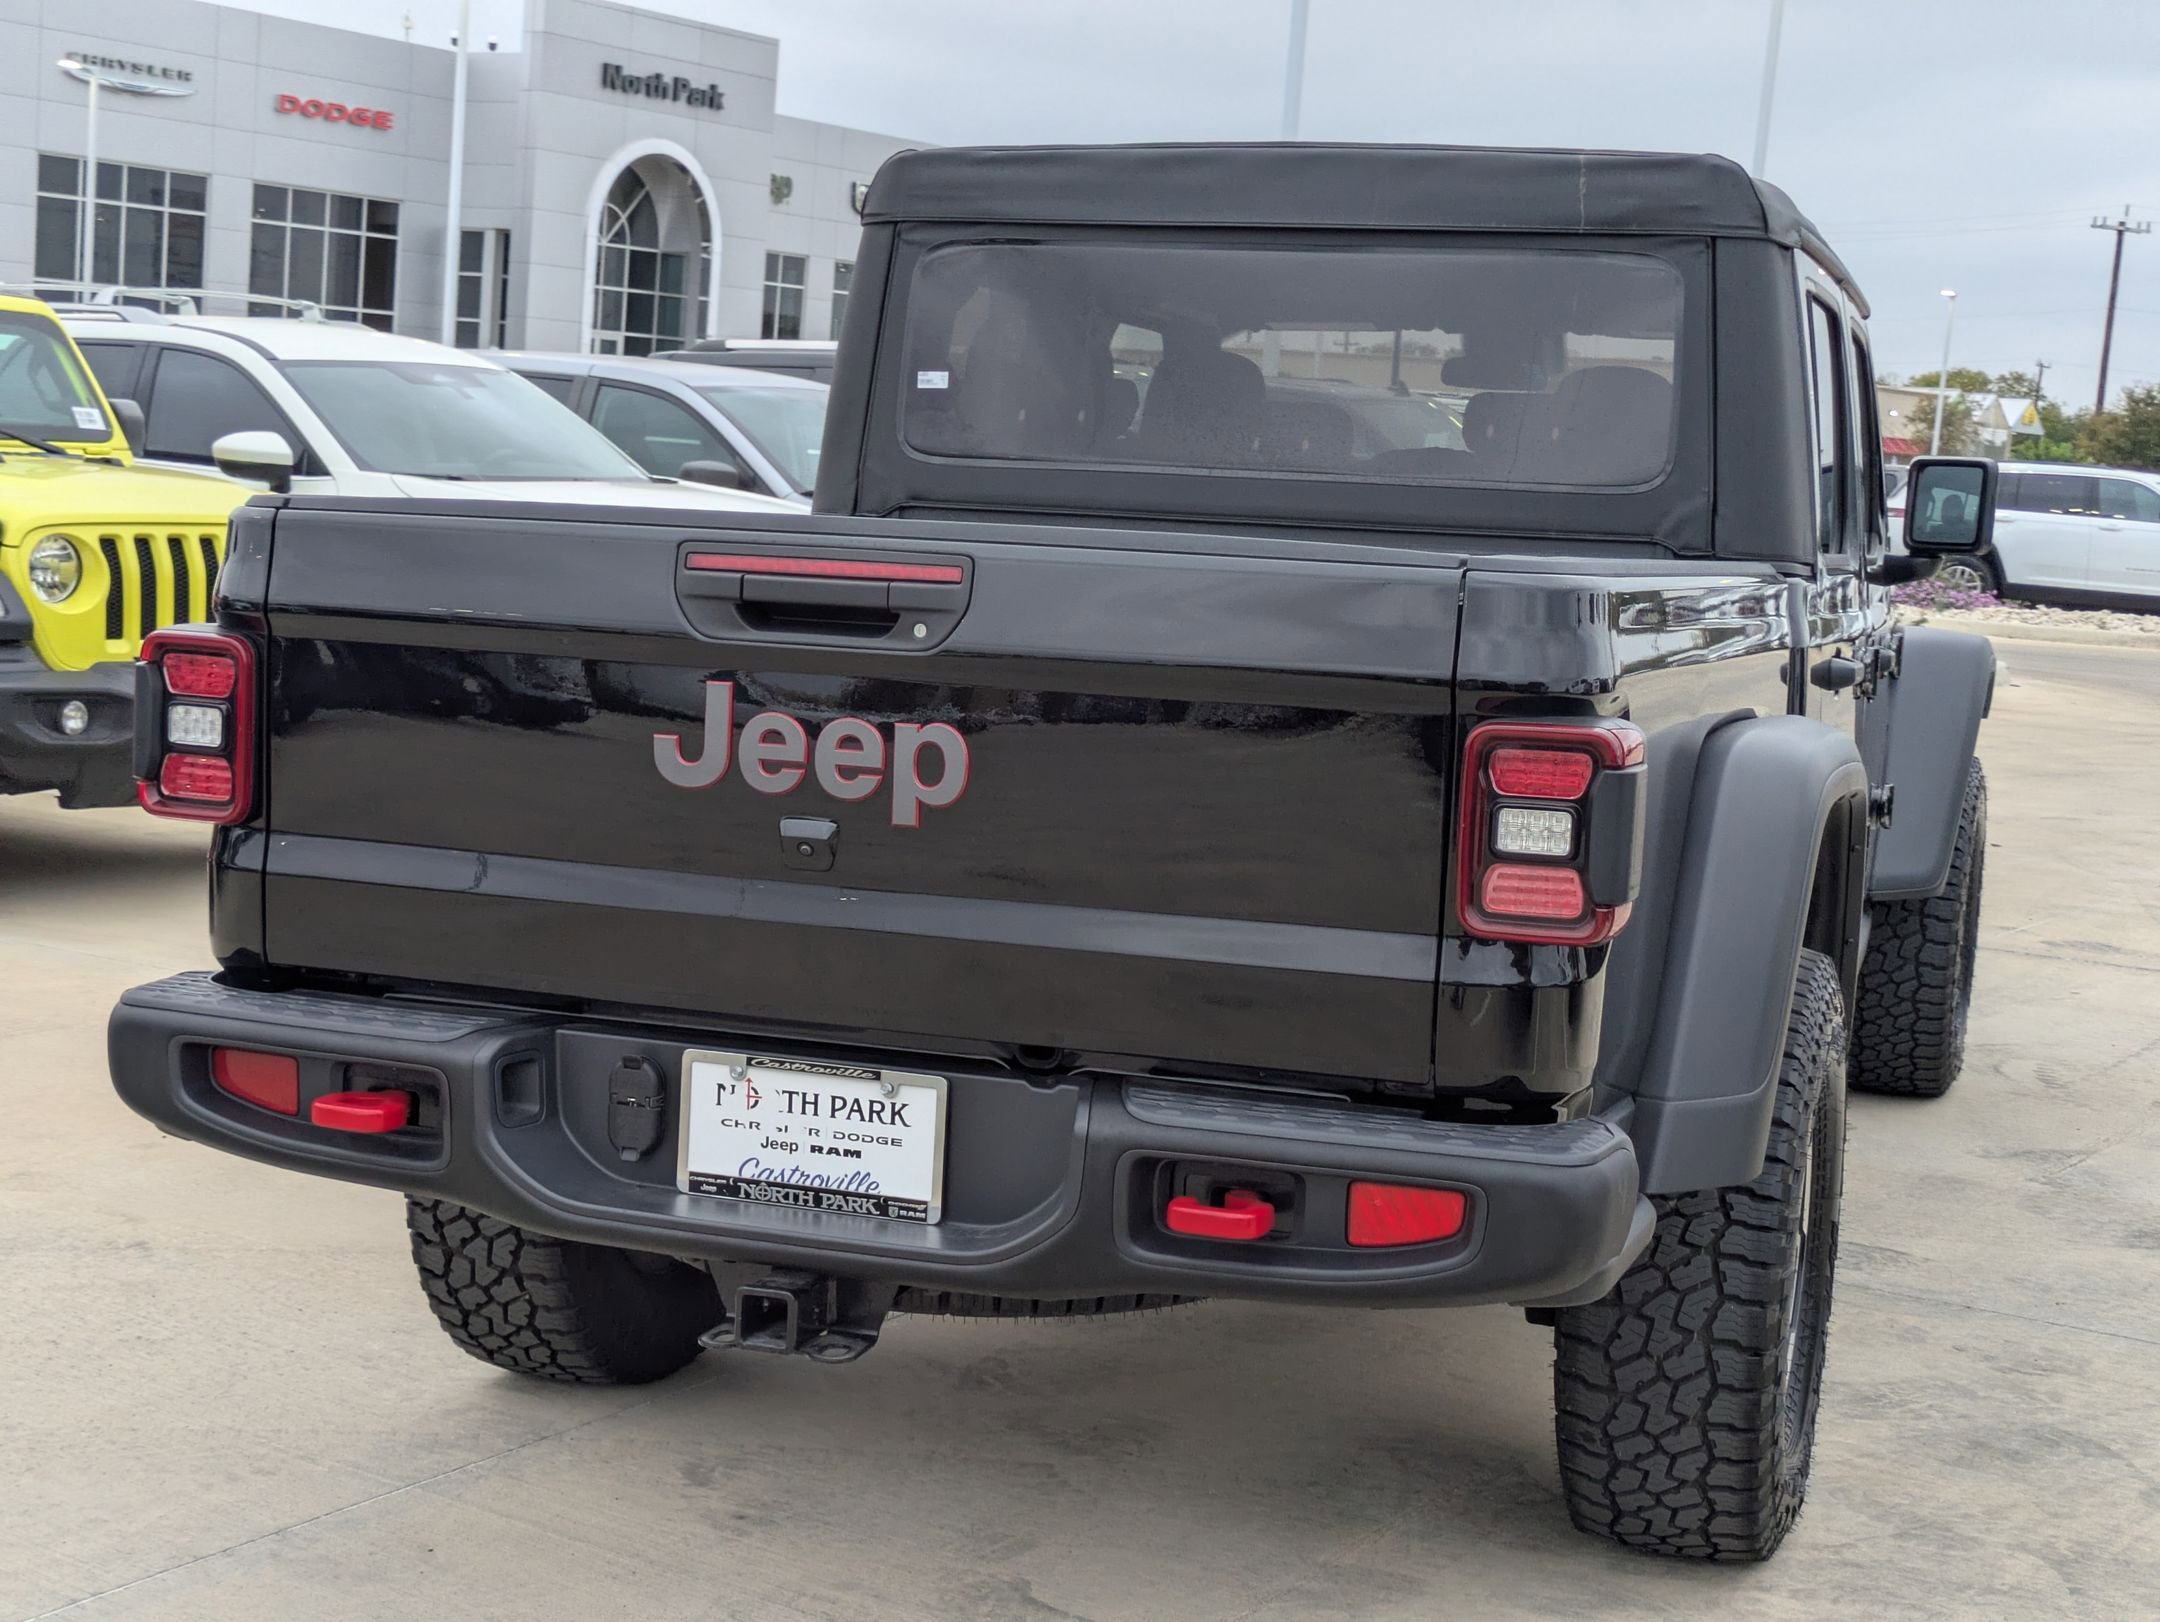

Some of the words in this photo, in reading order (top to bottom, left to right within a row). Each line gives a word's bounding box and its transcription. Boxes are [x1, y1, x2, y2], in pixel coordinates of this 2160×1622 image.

[602, 62, 670, 100] North
[672, 76, 725, 111] Park
[276, 93, 395, 131] DODGE
[653, 680, 971, 828] Jeep
[751, 1058, 877, 1080] Castroville
[829, 1095, 913, 1128] PARK
[760, 1136, 799, 1155] Jeep
[810, 1144, 862, 1160] RAM
[833, 1131, 904, 1148] DODGE
[738, 1157, 881, 1194] Castroville
[737, 1181, 815, 1208] NORTH
[819, 1192, 881, 1215] PARK
